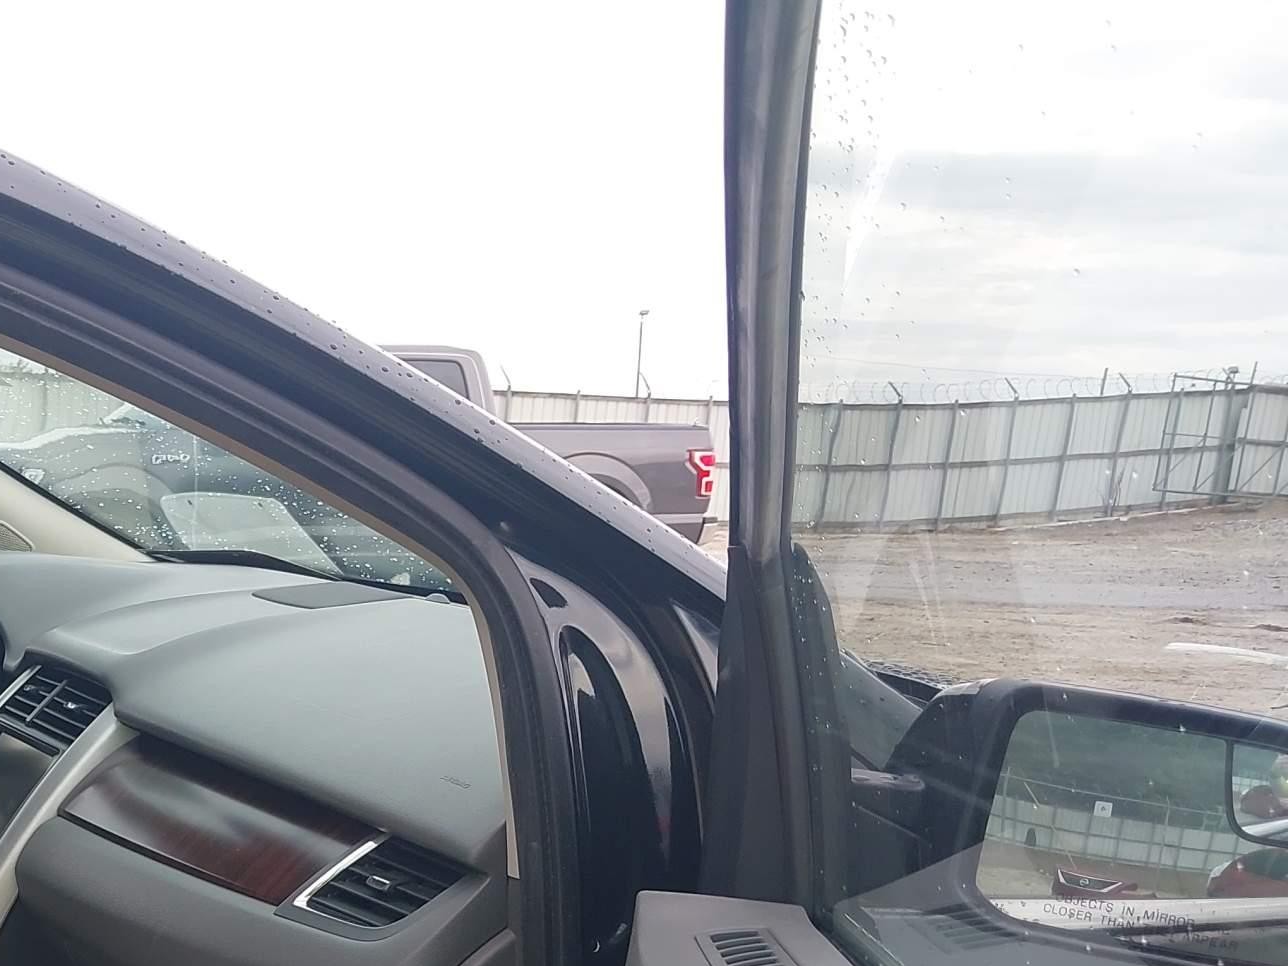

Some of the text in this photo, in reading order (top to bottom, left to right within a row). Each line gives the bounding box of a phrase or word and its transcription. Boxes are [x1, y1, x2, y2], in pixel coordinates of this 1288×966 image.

[1043, 903, 1093, 921] CLOSER
[1101, 915, 1135, 929] THAN
[1121, 905, 1135, 916] IN
